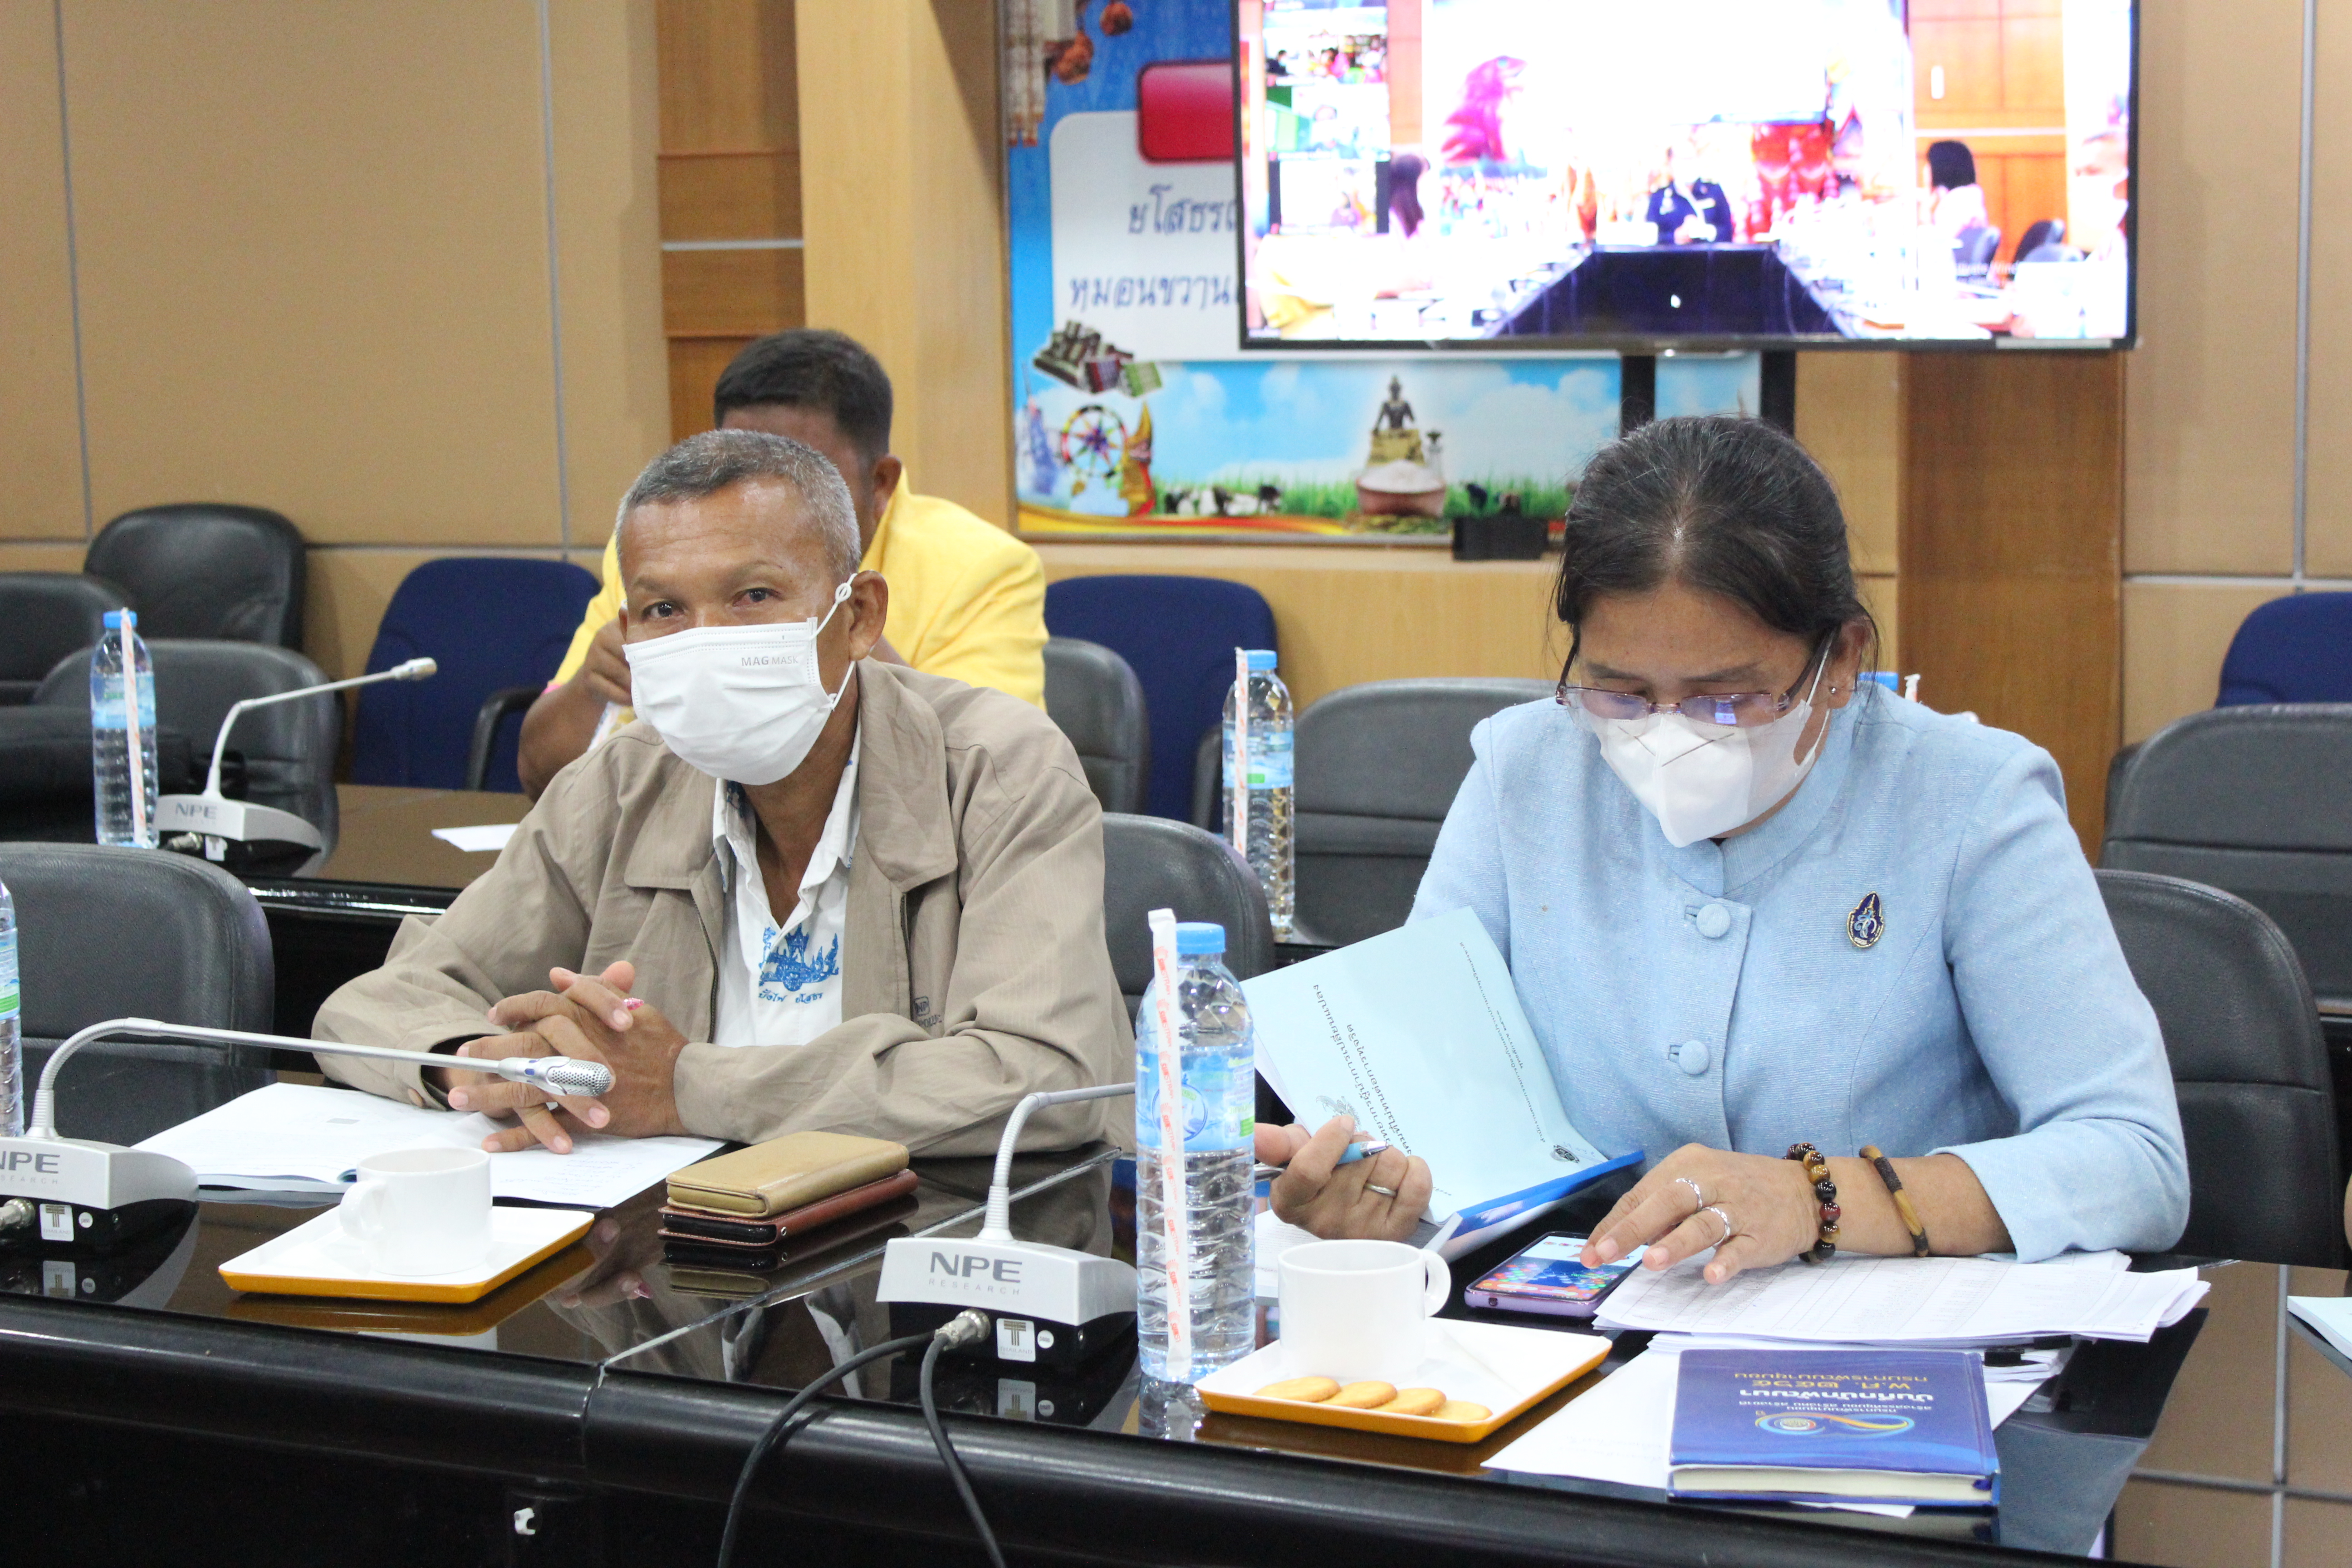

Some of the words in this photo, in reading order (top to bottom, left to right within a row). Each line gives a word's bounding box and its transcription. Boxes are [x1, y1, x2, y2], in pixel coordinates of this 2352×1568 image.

[1070, 277, 1238, 312] หมอนขวาน
[741, 656, 769, 666] MAG
[772, 656, 799, 665] MASK
[175, 803, 217, 819] NPE
[1313, 984, 1392, 1145] วทยากรผู้นำการเปลี่ยนแปลง
[0, 1151, 60, 1174] PE
[930, 1251, 1023, 1283] NPE
[929, 1278, 1019, 1295] RESEARCH
[1000, 1346, 1033, 1355] THAILAND
